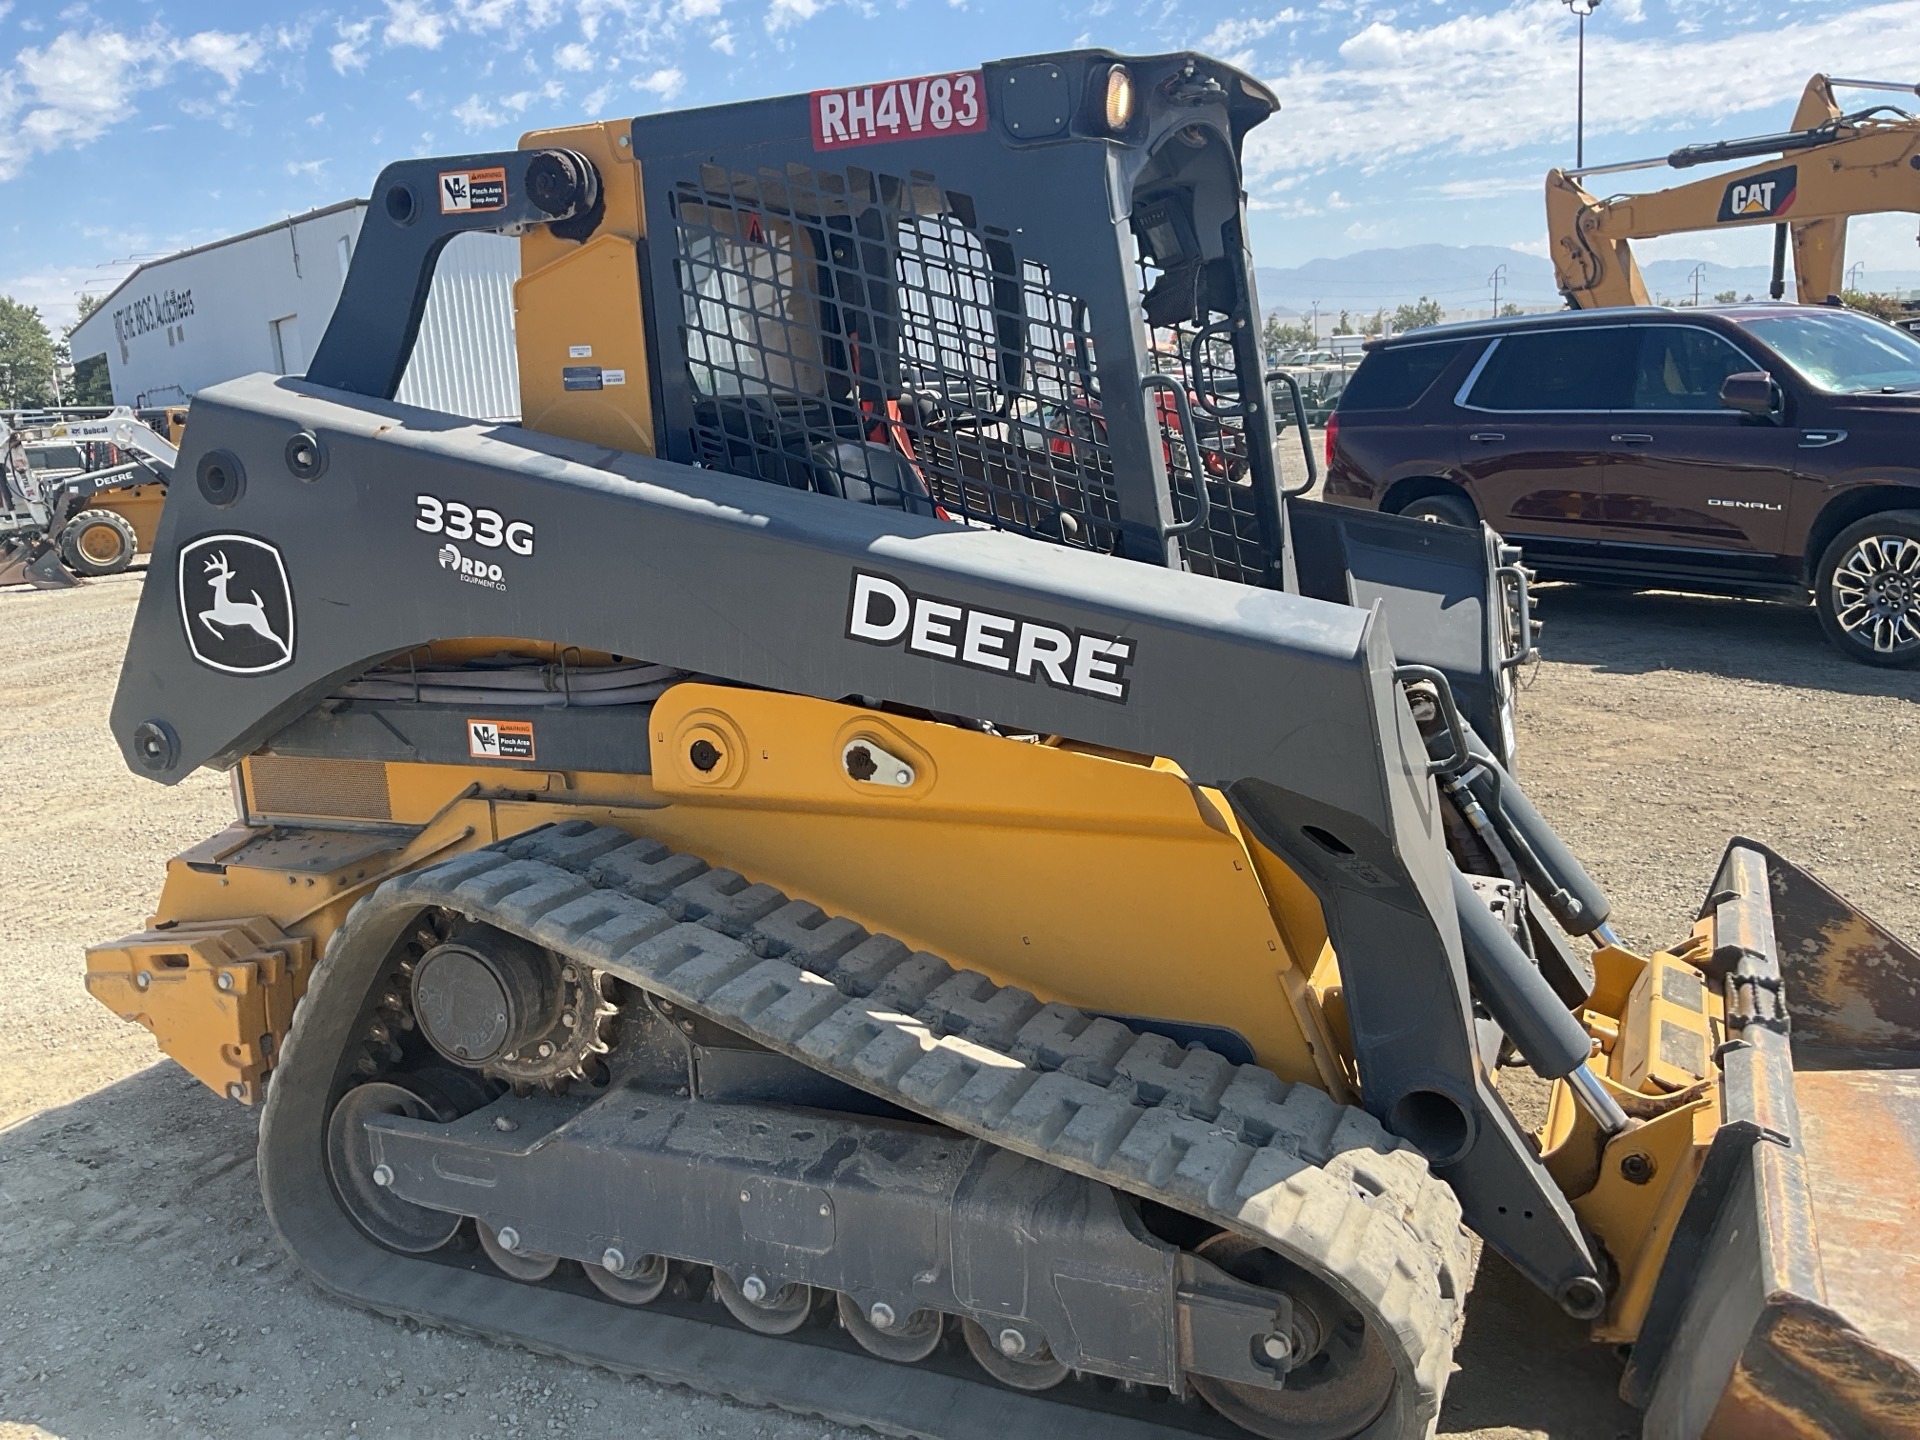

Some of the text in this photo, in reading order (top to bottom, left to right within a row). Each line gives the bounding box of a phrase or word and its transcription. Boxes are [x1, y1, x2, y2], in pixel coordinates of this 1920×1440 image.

[820, 75, 979, 143] RH4V83
[471, 187, 488, 195] Pinch
[1731, 181, 1776, 214] CAT
[83, 426, 109, 435] Bobcat
[94, 471, 134, 487] DEERE
[1707, 499, 1782, 511] DENALI
[416, 495, 534, 555] 333G
[460, 574, 495, 586] EQUIPMENT
[850, 573, 1130, 697] DEERE
[500, 737, 530, 746] Pinch Area
